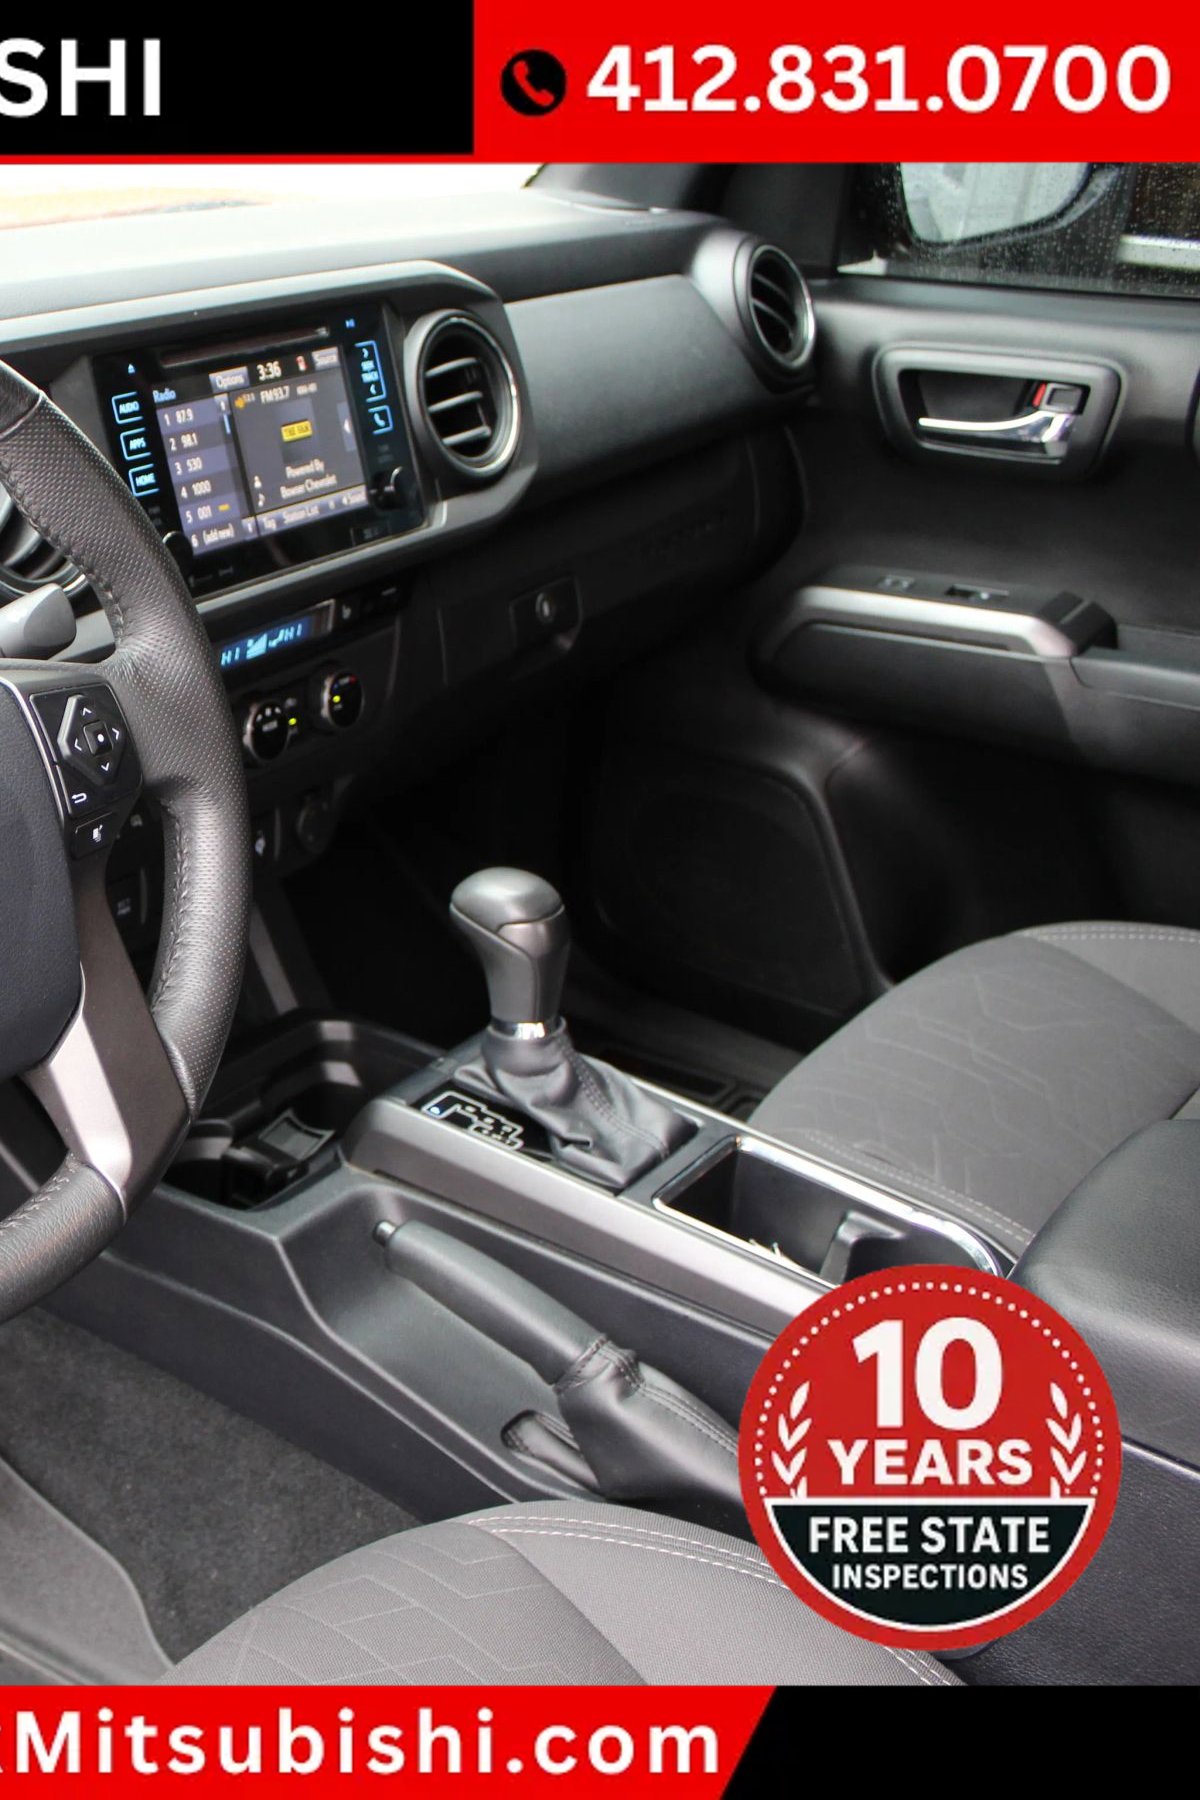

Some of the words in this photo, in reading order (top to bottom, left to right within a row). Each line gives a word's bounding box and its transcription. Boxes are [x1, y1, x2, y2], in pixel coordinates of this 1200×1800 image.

[257, 361, 282, 380] 3:36
[153, 388, 177, 402] Radio
[119, 401, 140, 414] AUDIO
[129, 437, 147, 450] APPS
[136, 473, 156, 487] HOME
[221, 647, 240, 666] HI
